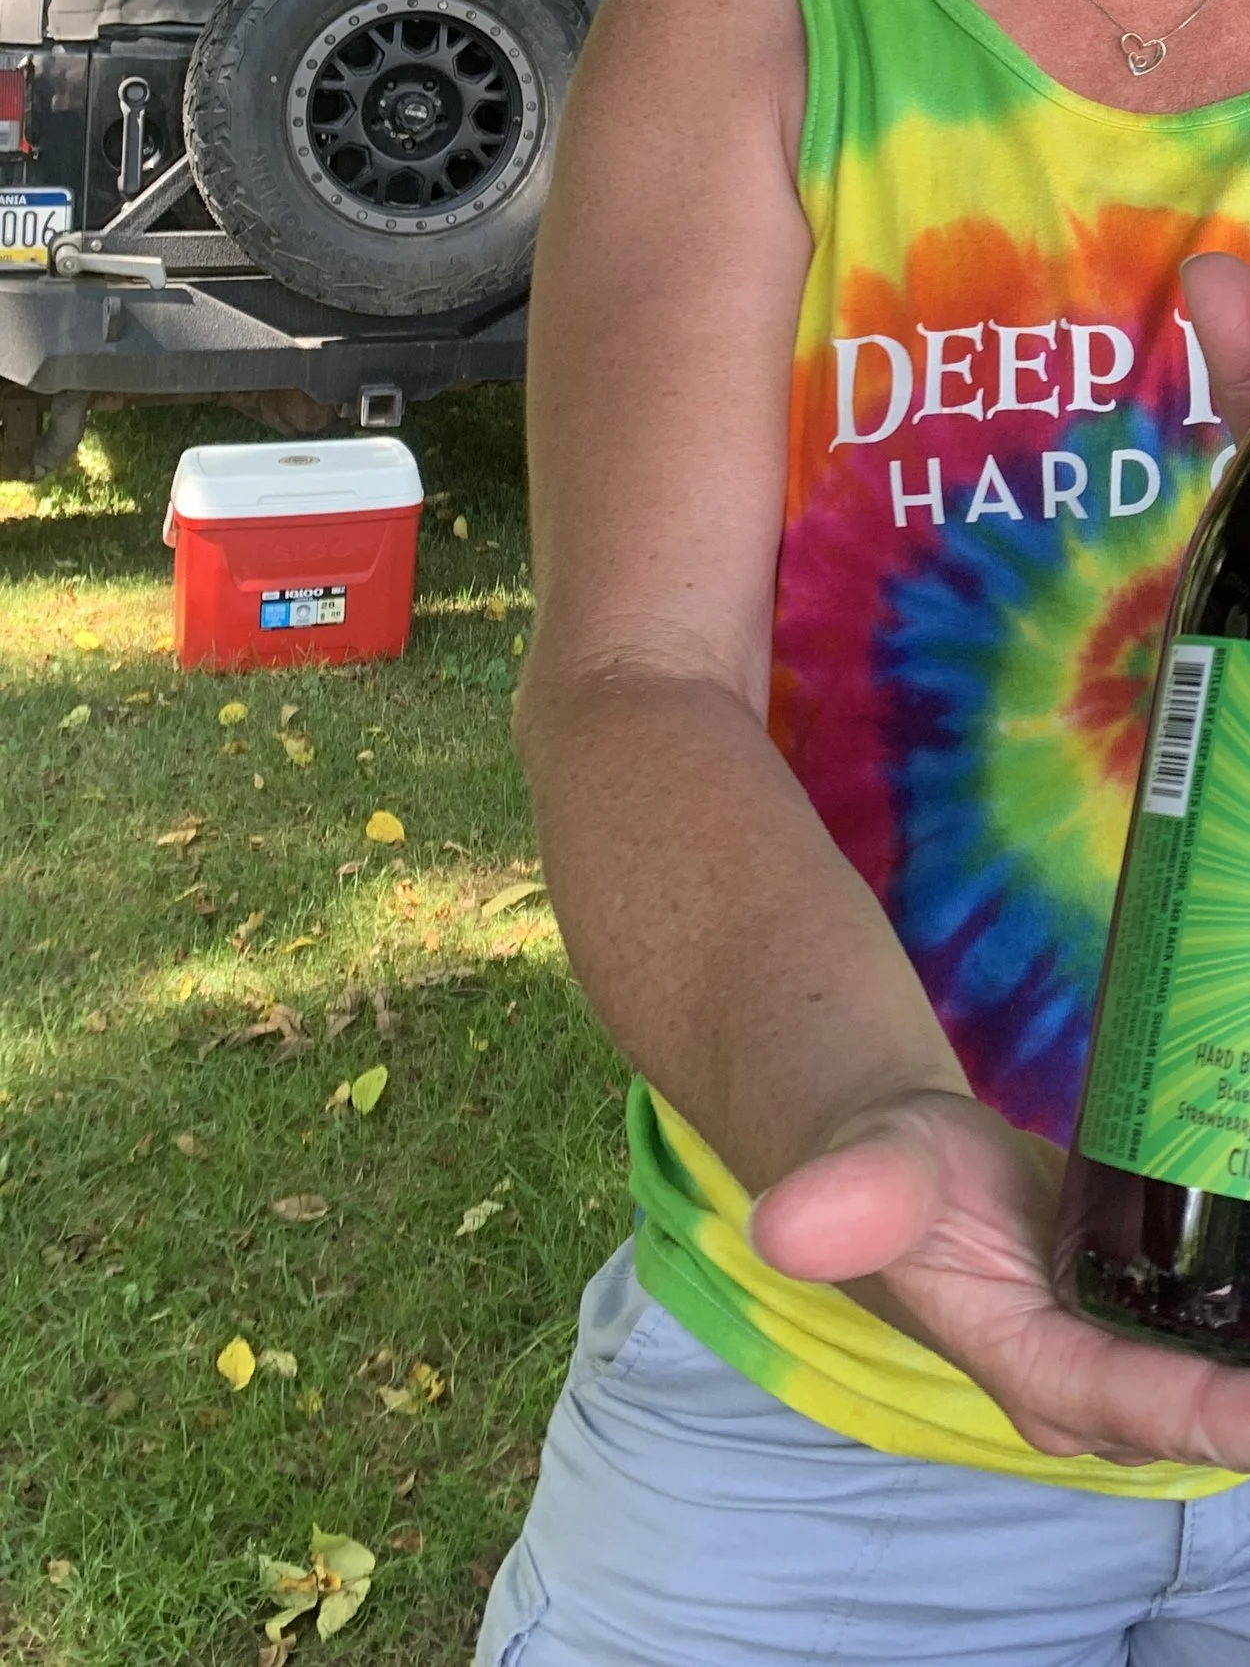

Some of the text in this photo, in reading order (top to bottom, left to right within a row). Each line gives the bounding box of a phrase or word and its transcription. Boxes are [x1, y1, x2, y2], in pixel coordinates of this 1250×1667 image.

[828, 317, 1134, 453] DEEP
[889, 449, 1161, 527] HARD
[1195, 1043, 1234, 1069] HARD
